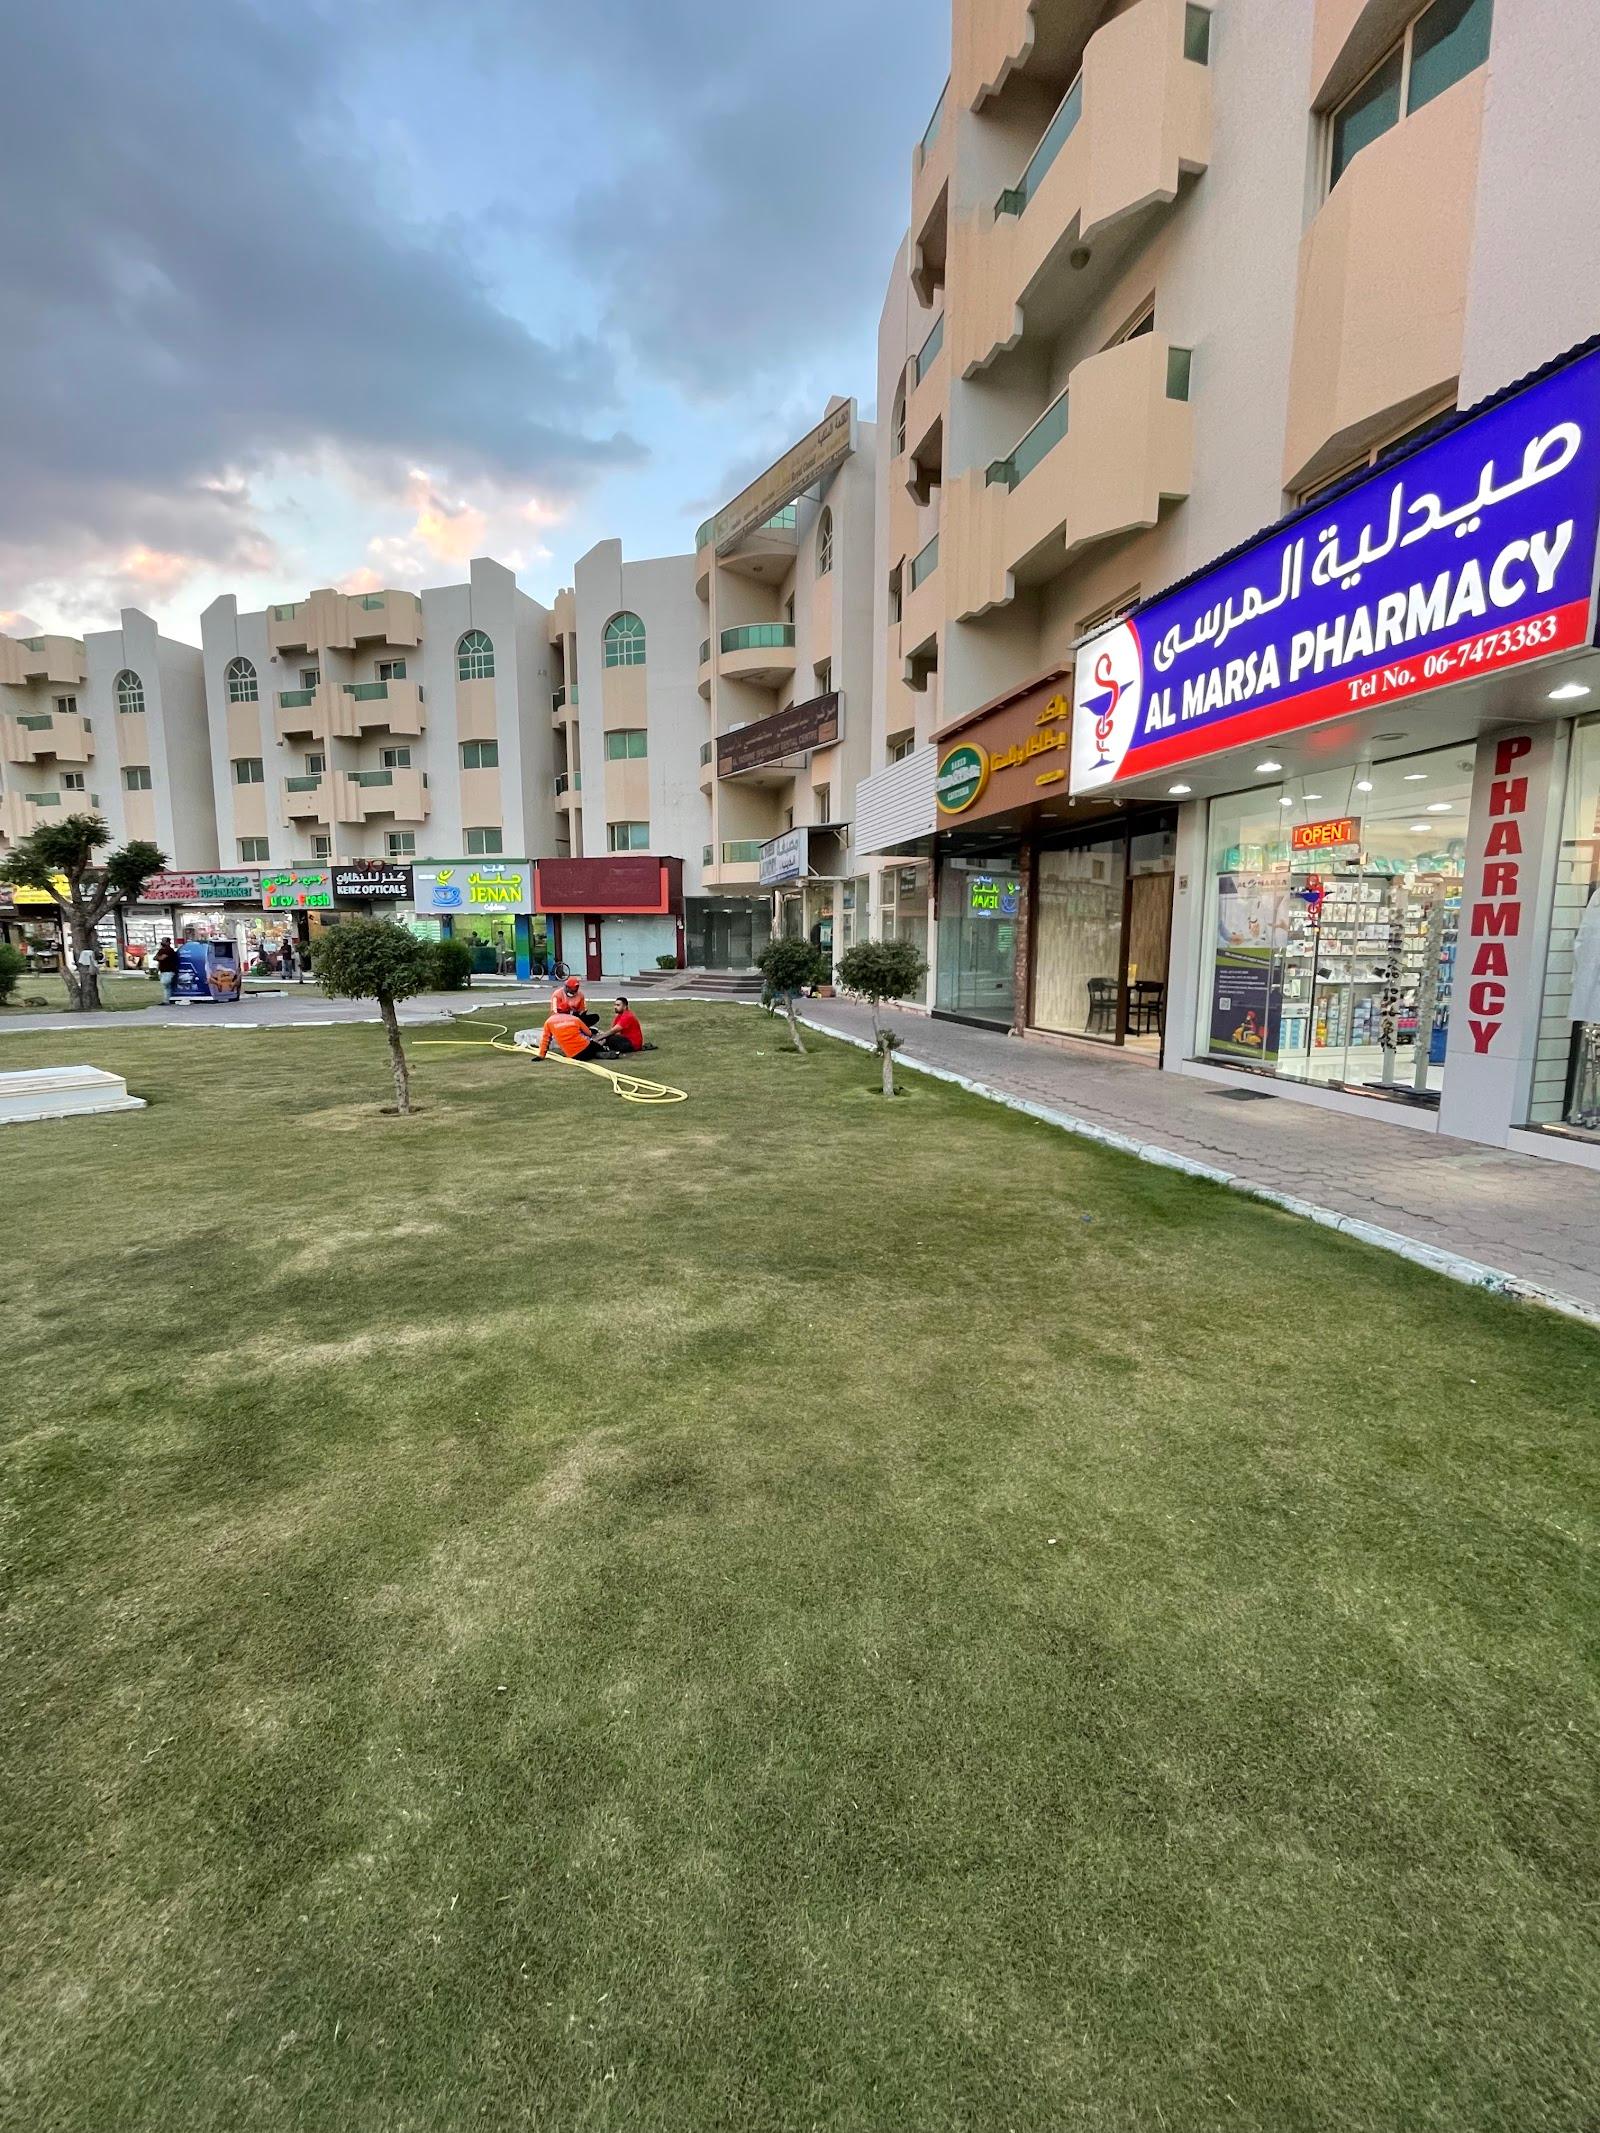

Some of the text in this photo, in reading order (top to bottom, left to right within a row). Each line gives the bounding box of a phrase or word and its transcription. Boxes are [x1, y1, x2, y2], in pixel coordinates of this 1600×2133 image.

[1153, 422, 1581, 672] صيدلية المرسى
[1144, 519, 1574, 734] AL MARSA PHARMACY
[1348, 615, 1557, 701] Tel No. 06-7473383
[1302, 824, 1342, 844] OPEN
[467, 872, 522, 887] جنان
[200, 887, 252, 898] SUPERMARKET
[337, 884, 408, 896] KENZ OPTICALS
[469, 886, 523, 903] JENAN
[1468, 736, 1532, 1054] PHARMACY
